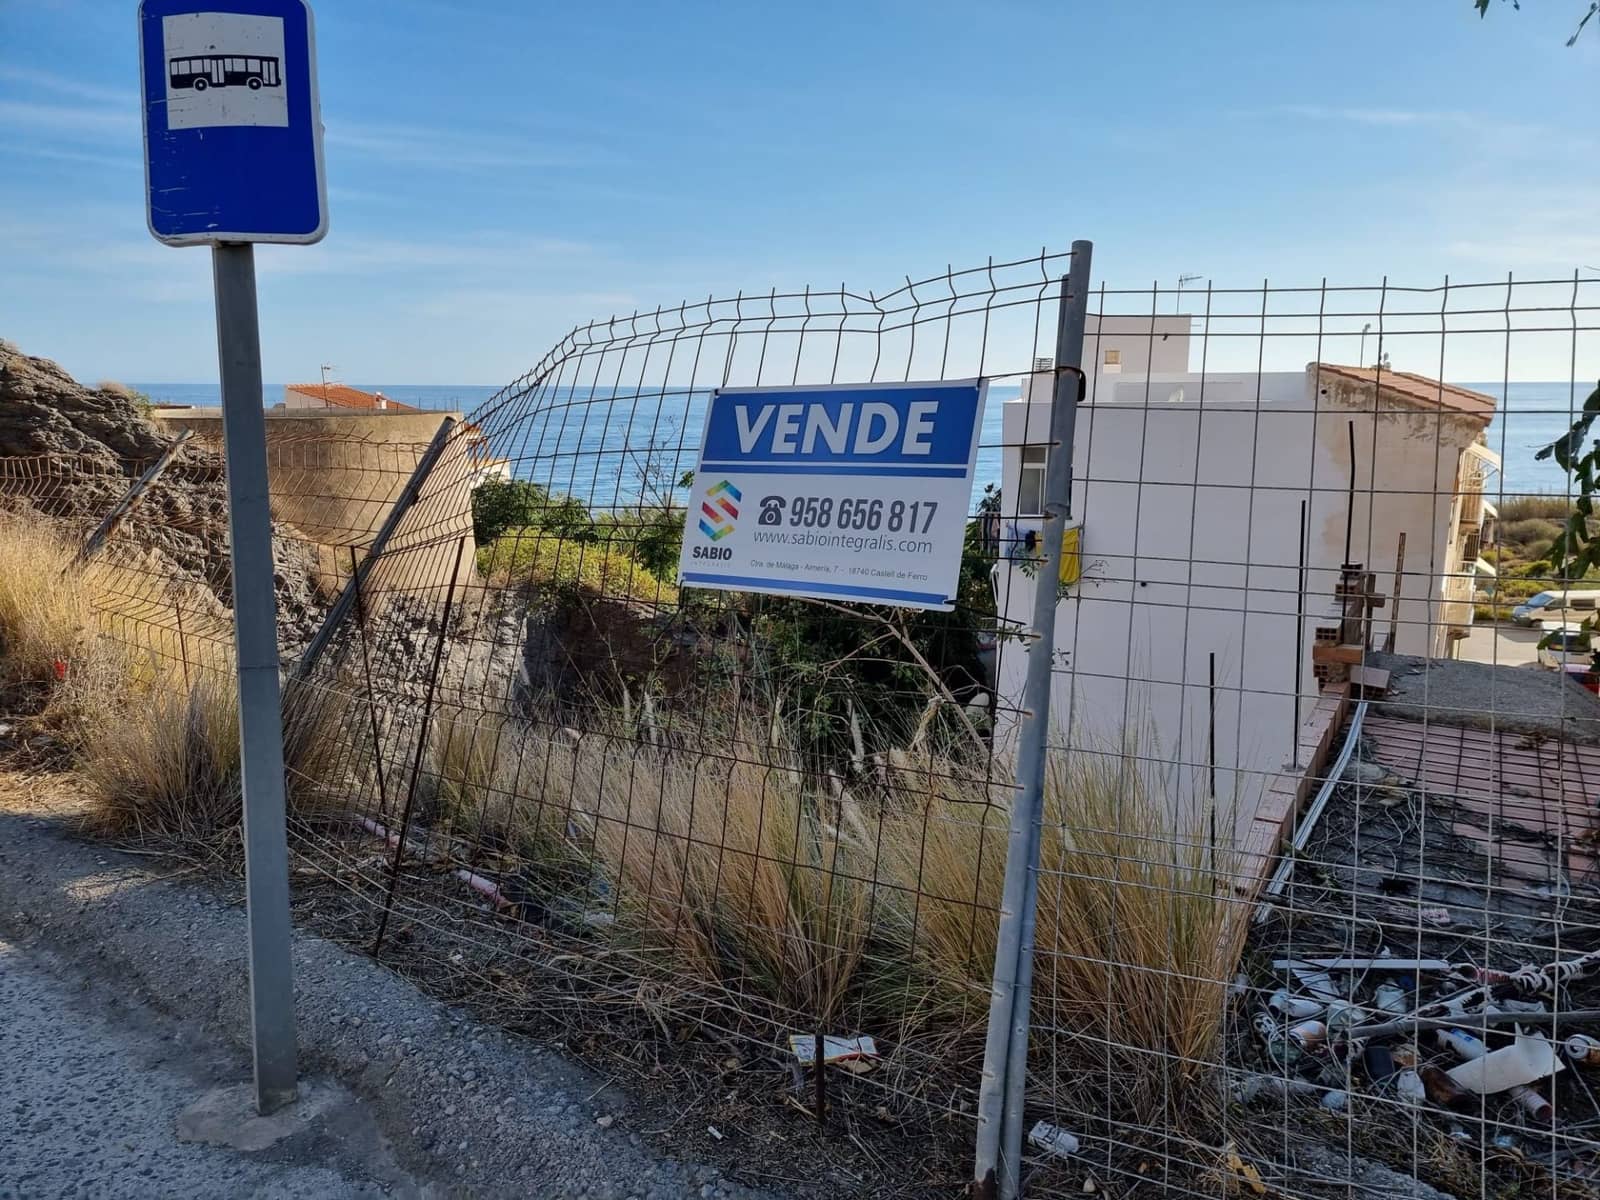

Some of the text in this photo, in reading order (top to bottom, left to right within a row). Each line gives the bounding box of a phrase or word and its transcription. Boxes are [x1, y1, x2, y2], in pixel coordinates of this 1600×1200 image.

[734, 401, 939, 455] VENDE
[789, 496, 938, 534] 958 656 817
[692, 546, 732, 560] SABIO
[752, 530, 932, 553] www.sabiointegralis.com
